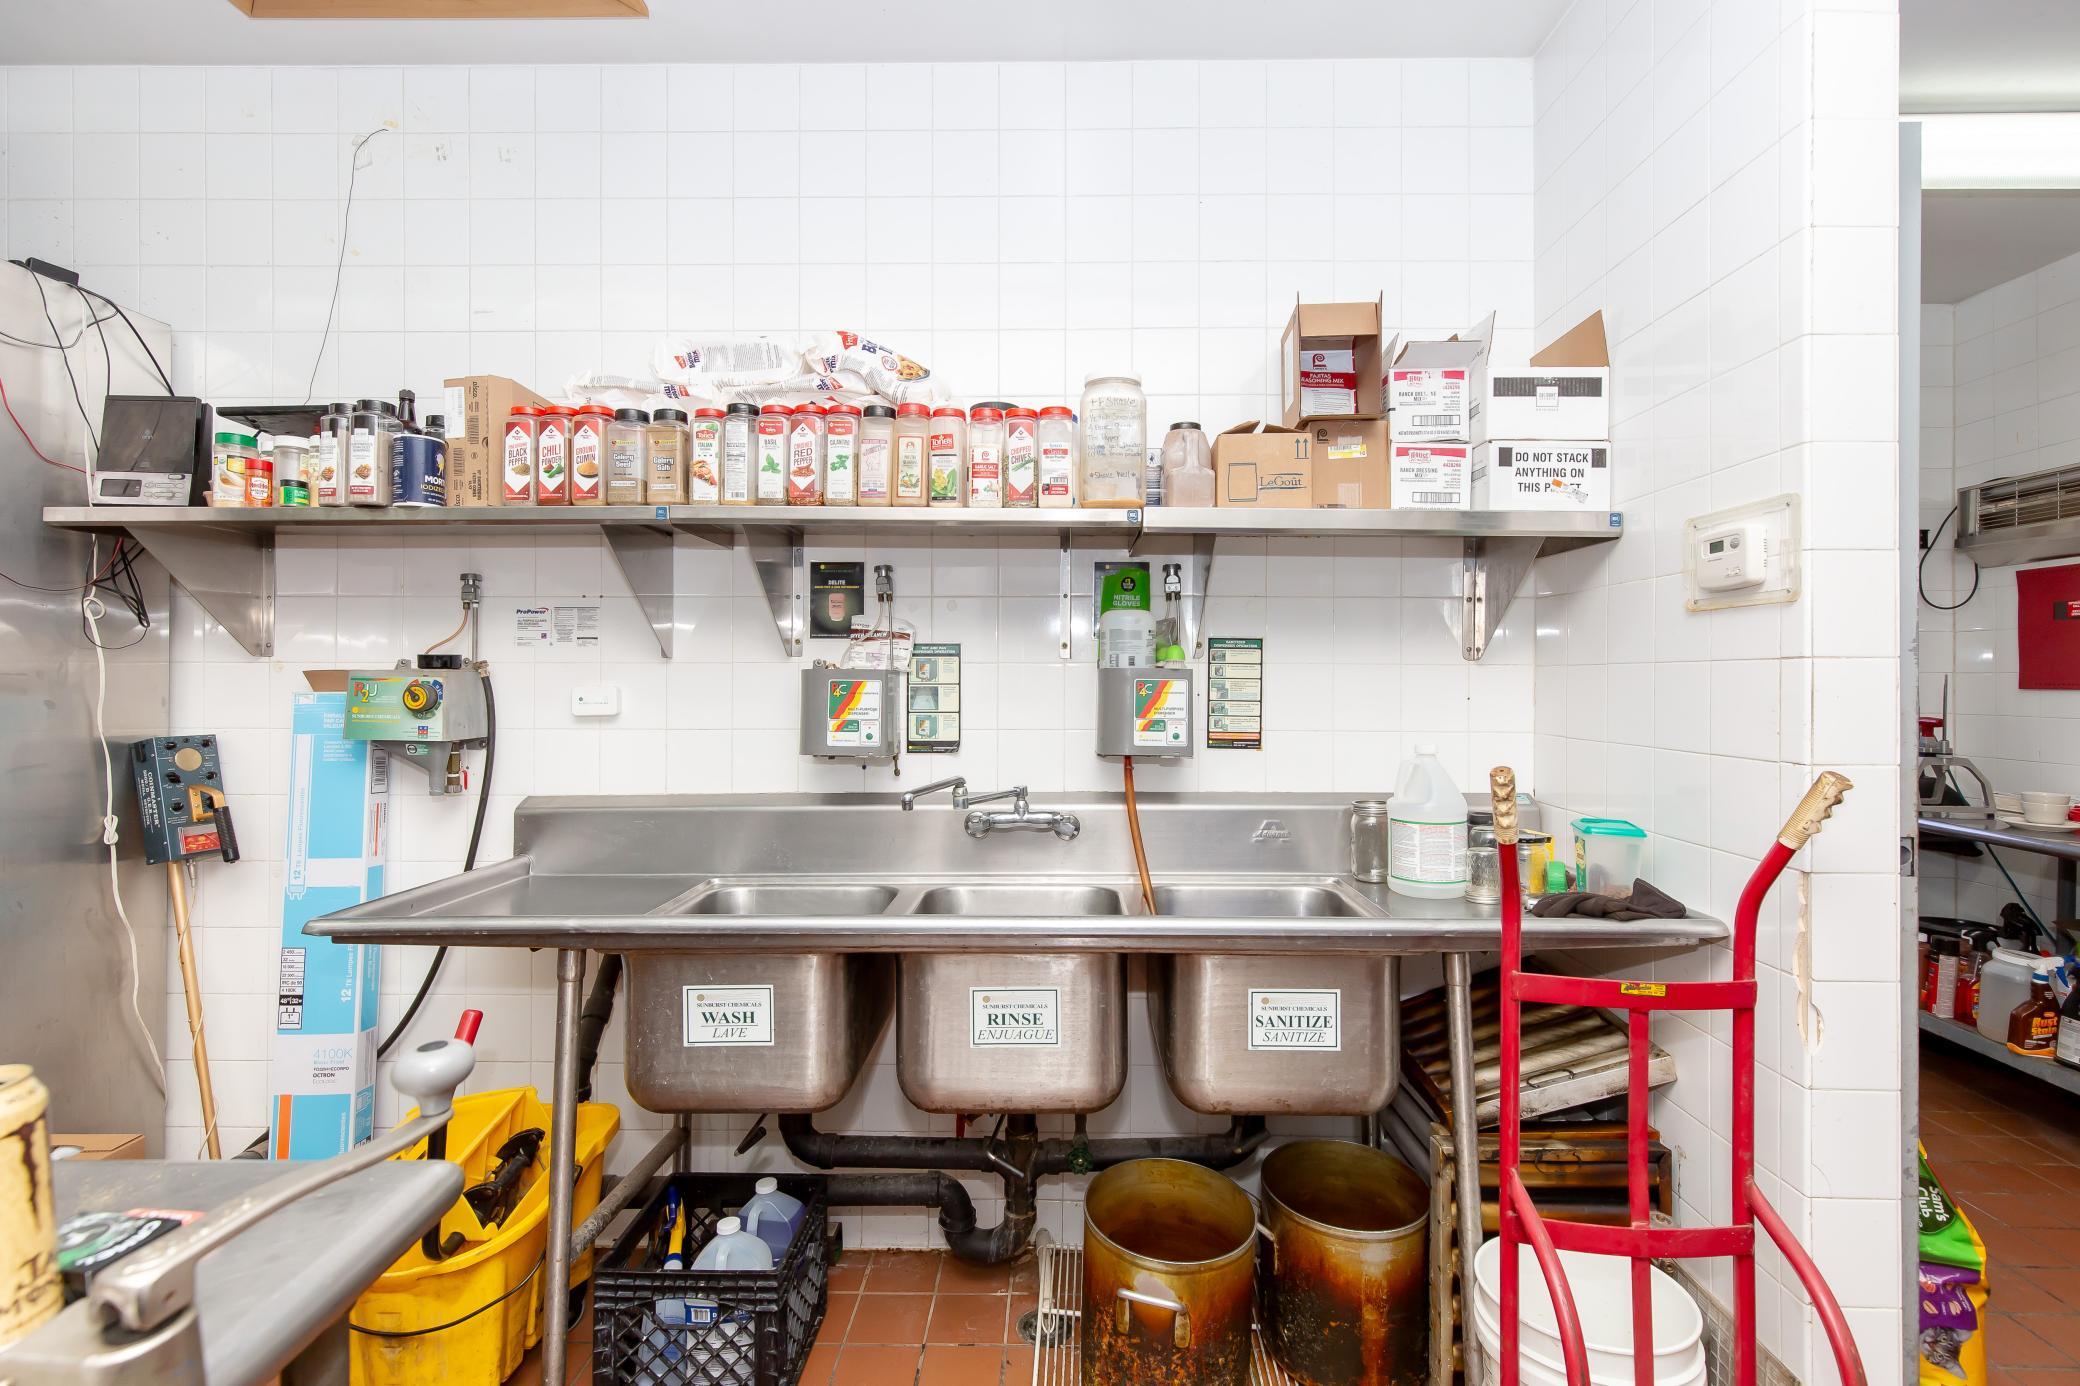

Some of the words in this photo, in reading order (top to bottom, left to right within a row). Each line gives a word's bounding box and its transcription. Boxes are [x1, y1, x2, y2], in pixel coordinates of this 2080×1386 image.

[508, 448, 527, 458] BLACK
[542, 444, 561, 457] CHILI
[576, 445, 596, 455] GROUND
[794, 448, 813, 458] RED
[1011, 446, 1031, 456] CHOPPED
[508, 457, 527, 466] PEPPER
[542, 456, 561, 466] POWDER
[576, 454, 596, 464] CUMIN
[653, 457, 674, 465] Celery
[793, 457, 813, 466] PEPPER
[1011, 453, 1032, 465] CHIVES
[1516, 452, 1528, 462] DO
[1533, 453, 1552, 462] NOT
[1557, 453, 1588, 462] STACK
[616, 460, 631, 468] Seed
[1515, 468, 1566, 477] ANYTHING
[1570, 468, 1584, 477] ON
[1260, 475, 1302, 487] LeGoût
[1518, 483, 1540, 492] THIS
[148, 772, 160, 827] COINMASTER
[294, 870, 300, 880] 12
[341, 989, 351, 1002] 12
[701, 1012, 755, 1024] WASH
[987, 1013, 1044, 1026] RINSE
[1255, 1015, 1333, 1028] SANITIZE
[2033, 1017, 2058, 1027] Rust
[712, 1027, 748, 1038] LAVE
[978, 1029, 1054, 1040] ENJUAGUE
[2031, 1027, 2057, 1035] Stain
[1263, 1032, 1326, 1042] SANITIZE
[313, 1048, 352, 1059] 4100K
[1919, 1186, 1931, 1218] Club
[1929, 1186, 1947, 1222] Sam's
